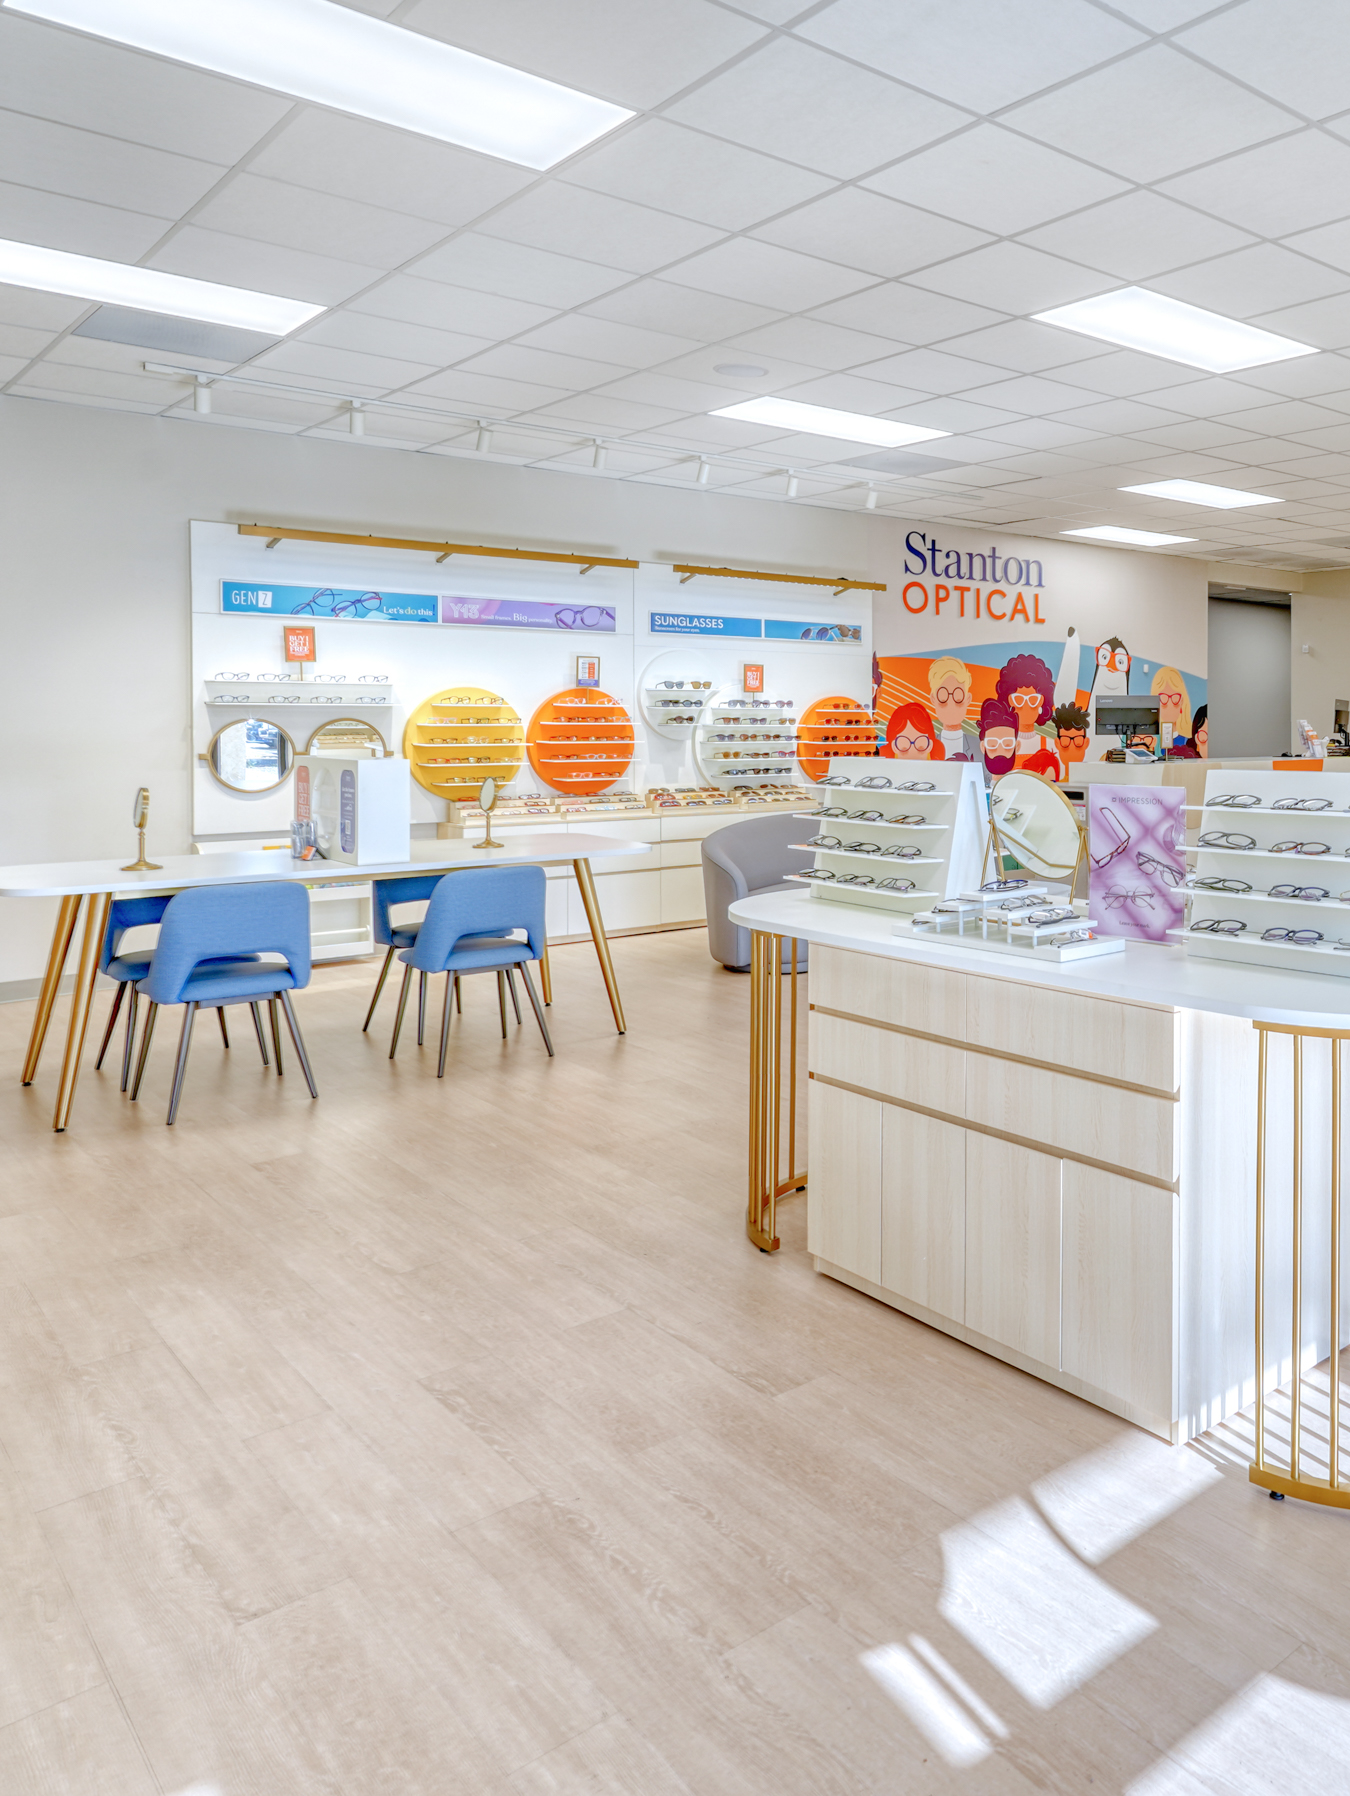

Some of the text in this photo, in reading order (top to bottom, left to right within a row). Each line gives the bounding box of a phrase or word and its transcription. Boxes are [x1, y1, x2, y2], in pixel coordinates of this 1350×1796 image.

[904, 531, 1045, 588] Stanton
[231, 590, 257, 605] GEN
[902, 581, 1046, 624] OPTICAL
[383, 604, 436, 616] Let's do this!
[513, 613, 528, 623] Big
[654, 615, 724, 629] SUNGLASSES
[1118, 797, 1163, 806] IMPRESSION
